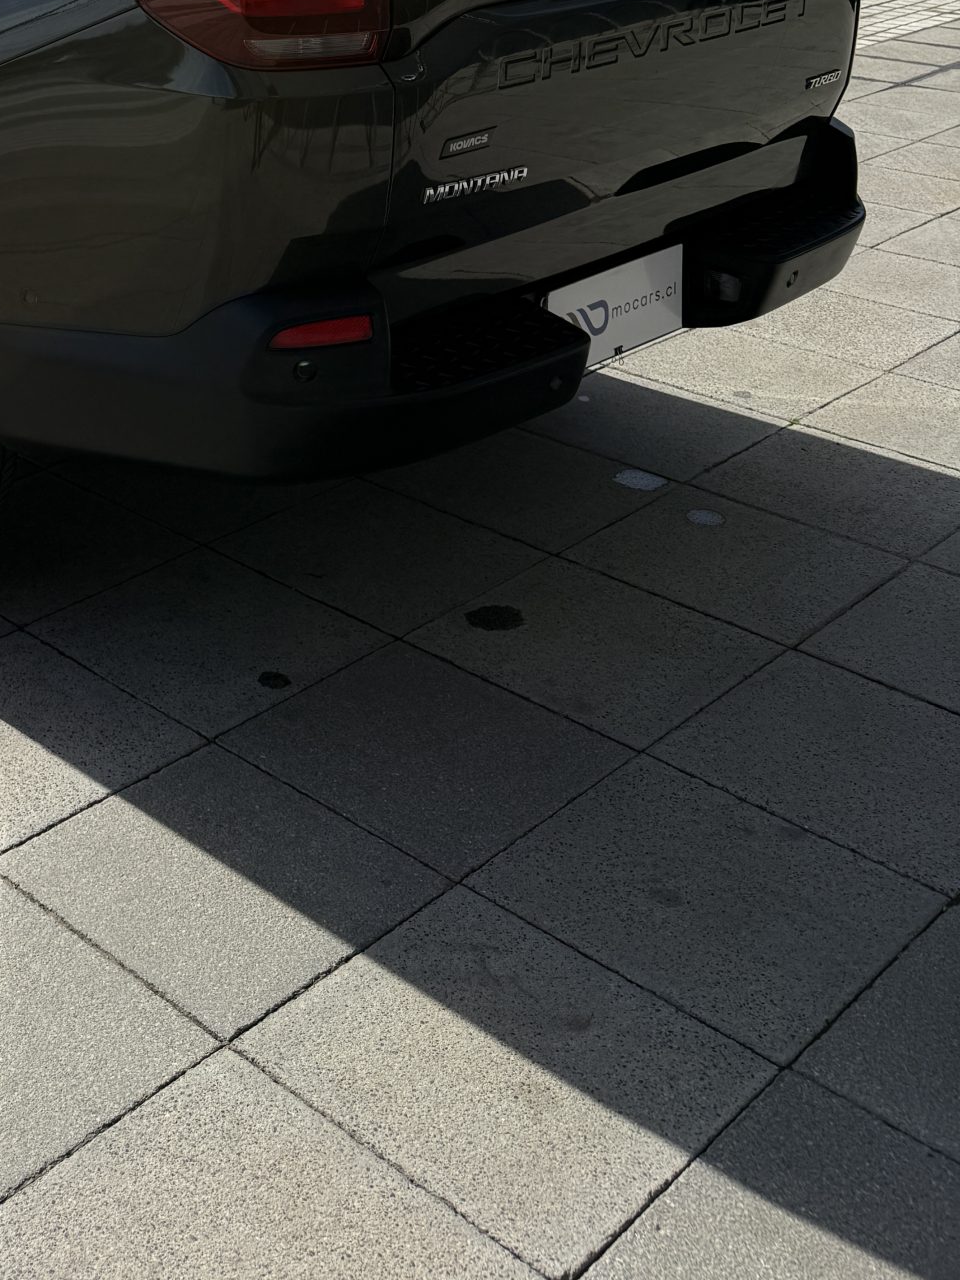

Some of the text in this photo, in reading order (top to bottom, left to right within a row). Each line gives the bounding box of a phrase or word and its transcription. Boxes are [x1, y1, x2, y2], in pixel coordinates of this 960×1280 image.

[809, 70, 842, 90] TURBO
[449, 132, 489, 153] KOVACS
[423, 165, 528, 205] MONTANA
[611, 281, 678, 320] mocars.cl
